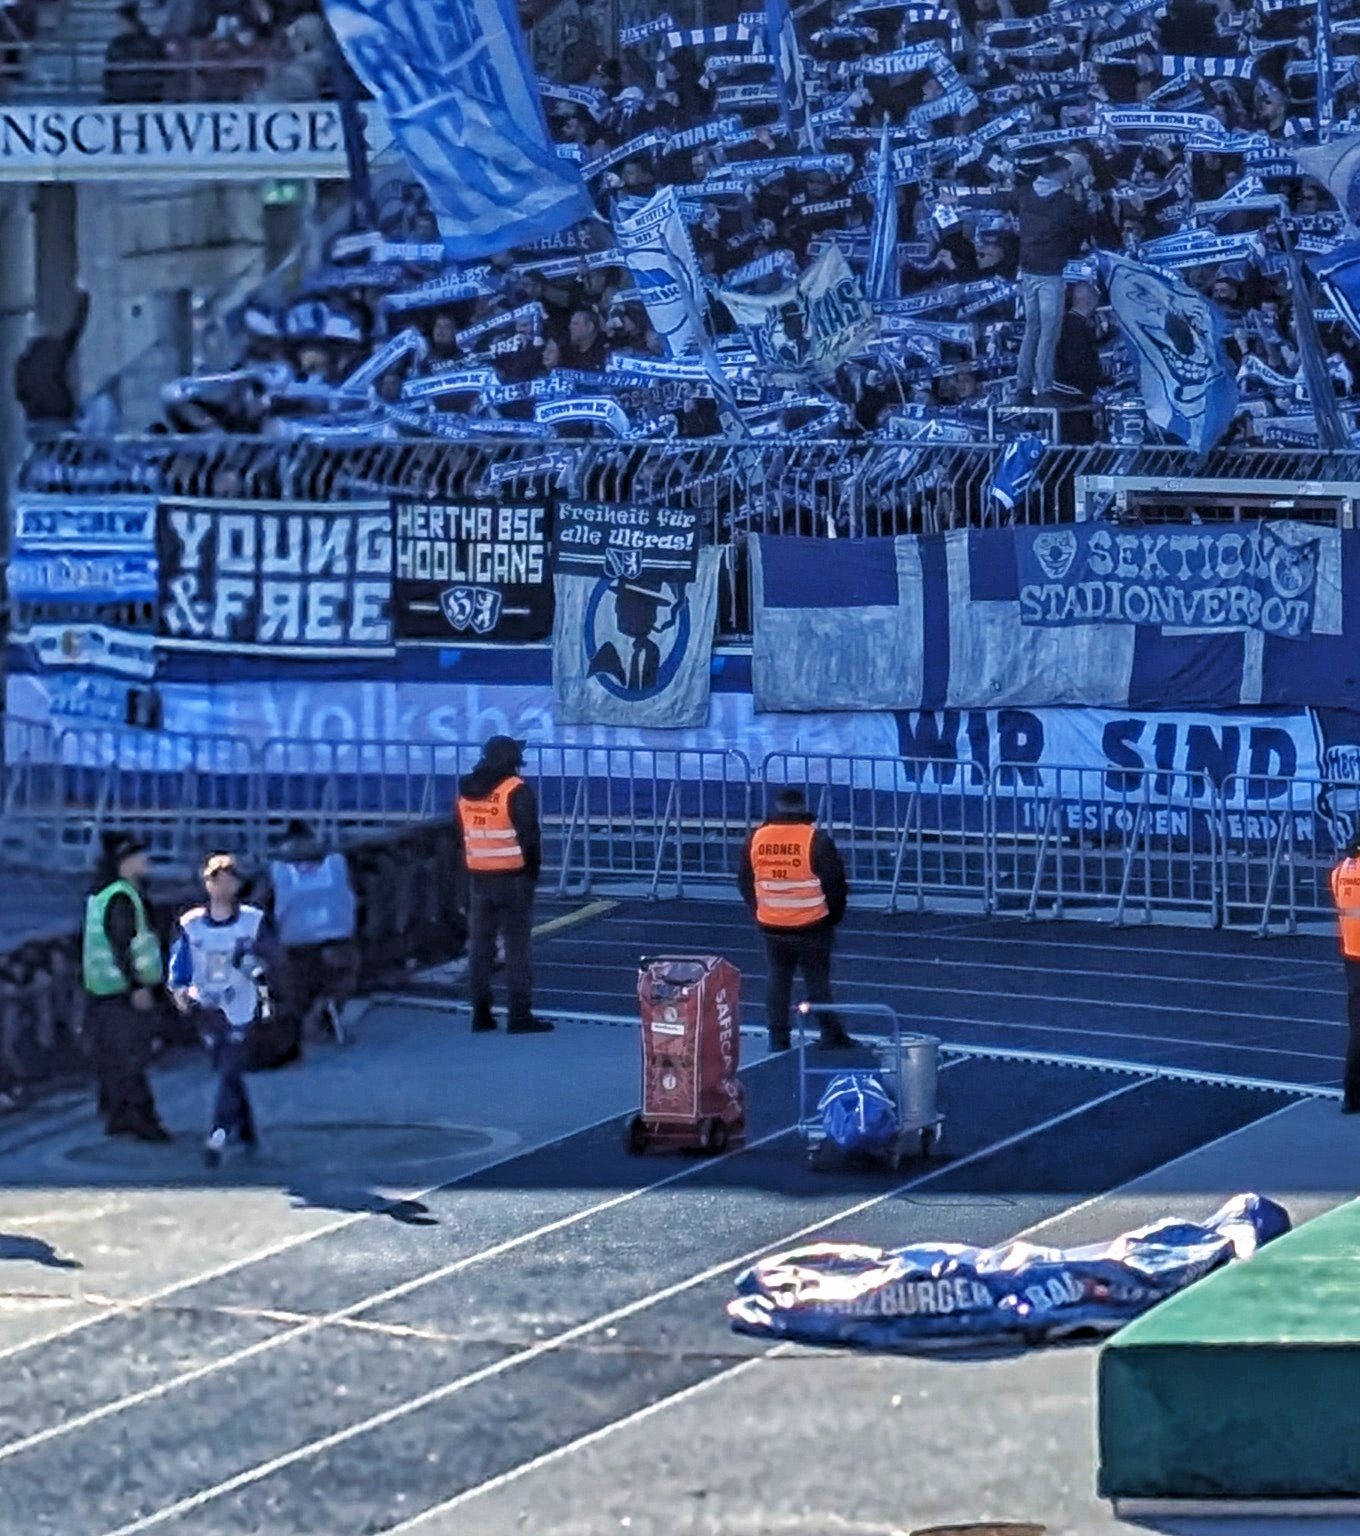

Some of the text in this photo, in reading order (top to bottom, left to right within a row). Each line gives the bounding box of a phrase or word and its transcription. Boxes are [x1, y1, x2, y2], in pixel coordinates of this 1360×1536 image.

[398, 506, 544, 542] HERTHA BSC
[558, 503, 696, 532] Freiheit für
[559, 525, 600, 546] alle
[398, 543, 543, 584] HOOLIGANS
[1087, 538, 1271, 580] SEKTION
[1020, 583, 1308, 636] STADIONVERBOT
[900, 712, 1044, 788] WIR
[1103, 718, 1297, 799] SIND
[758, 843, 801, 855] ORDNER
